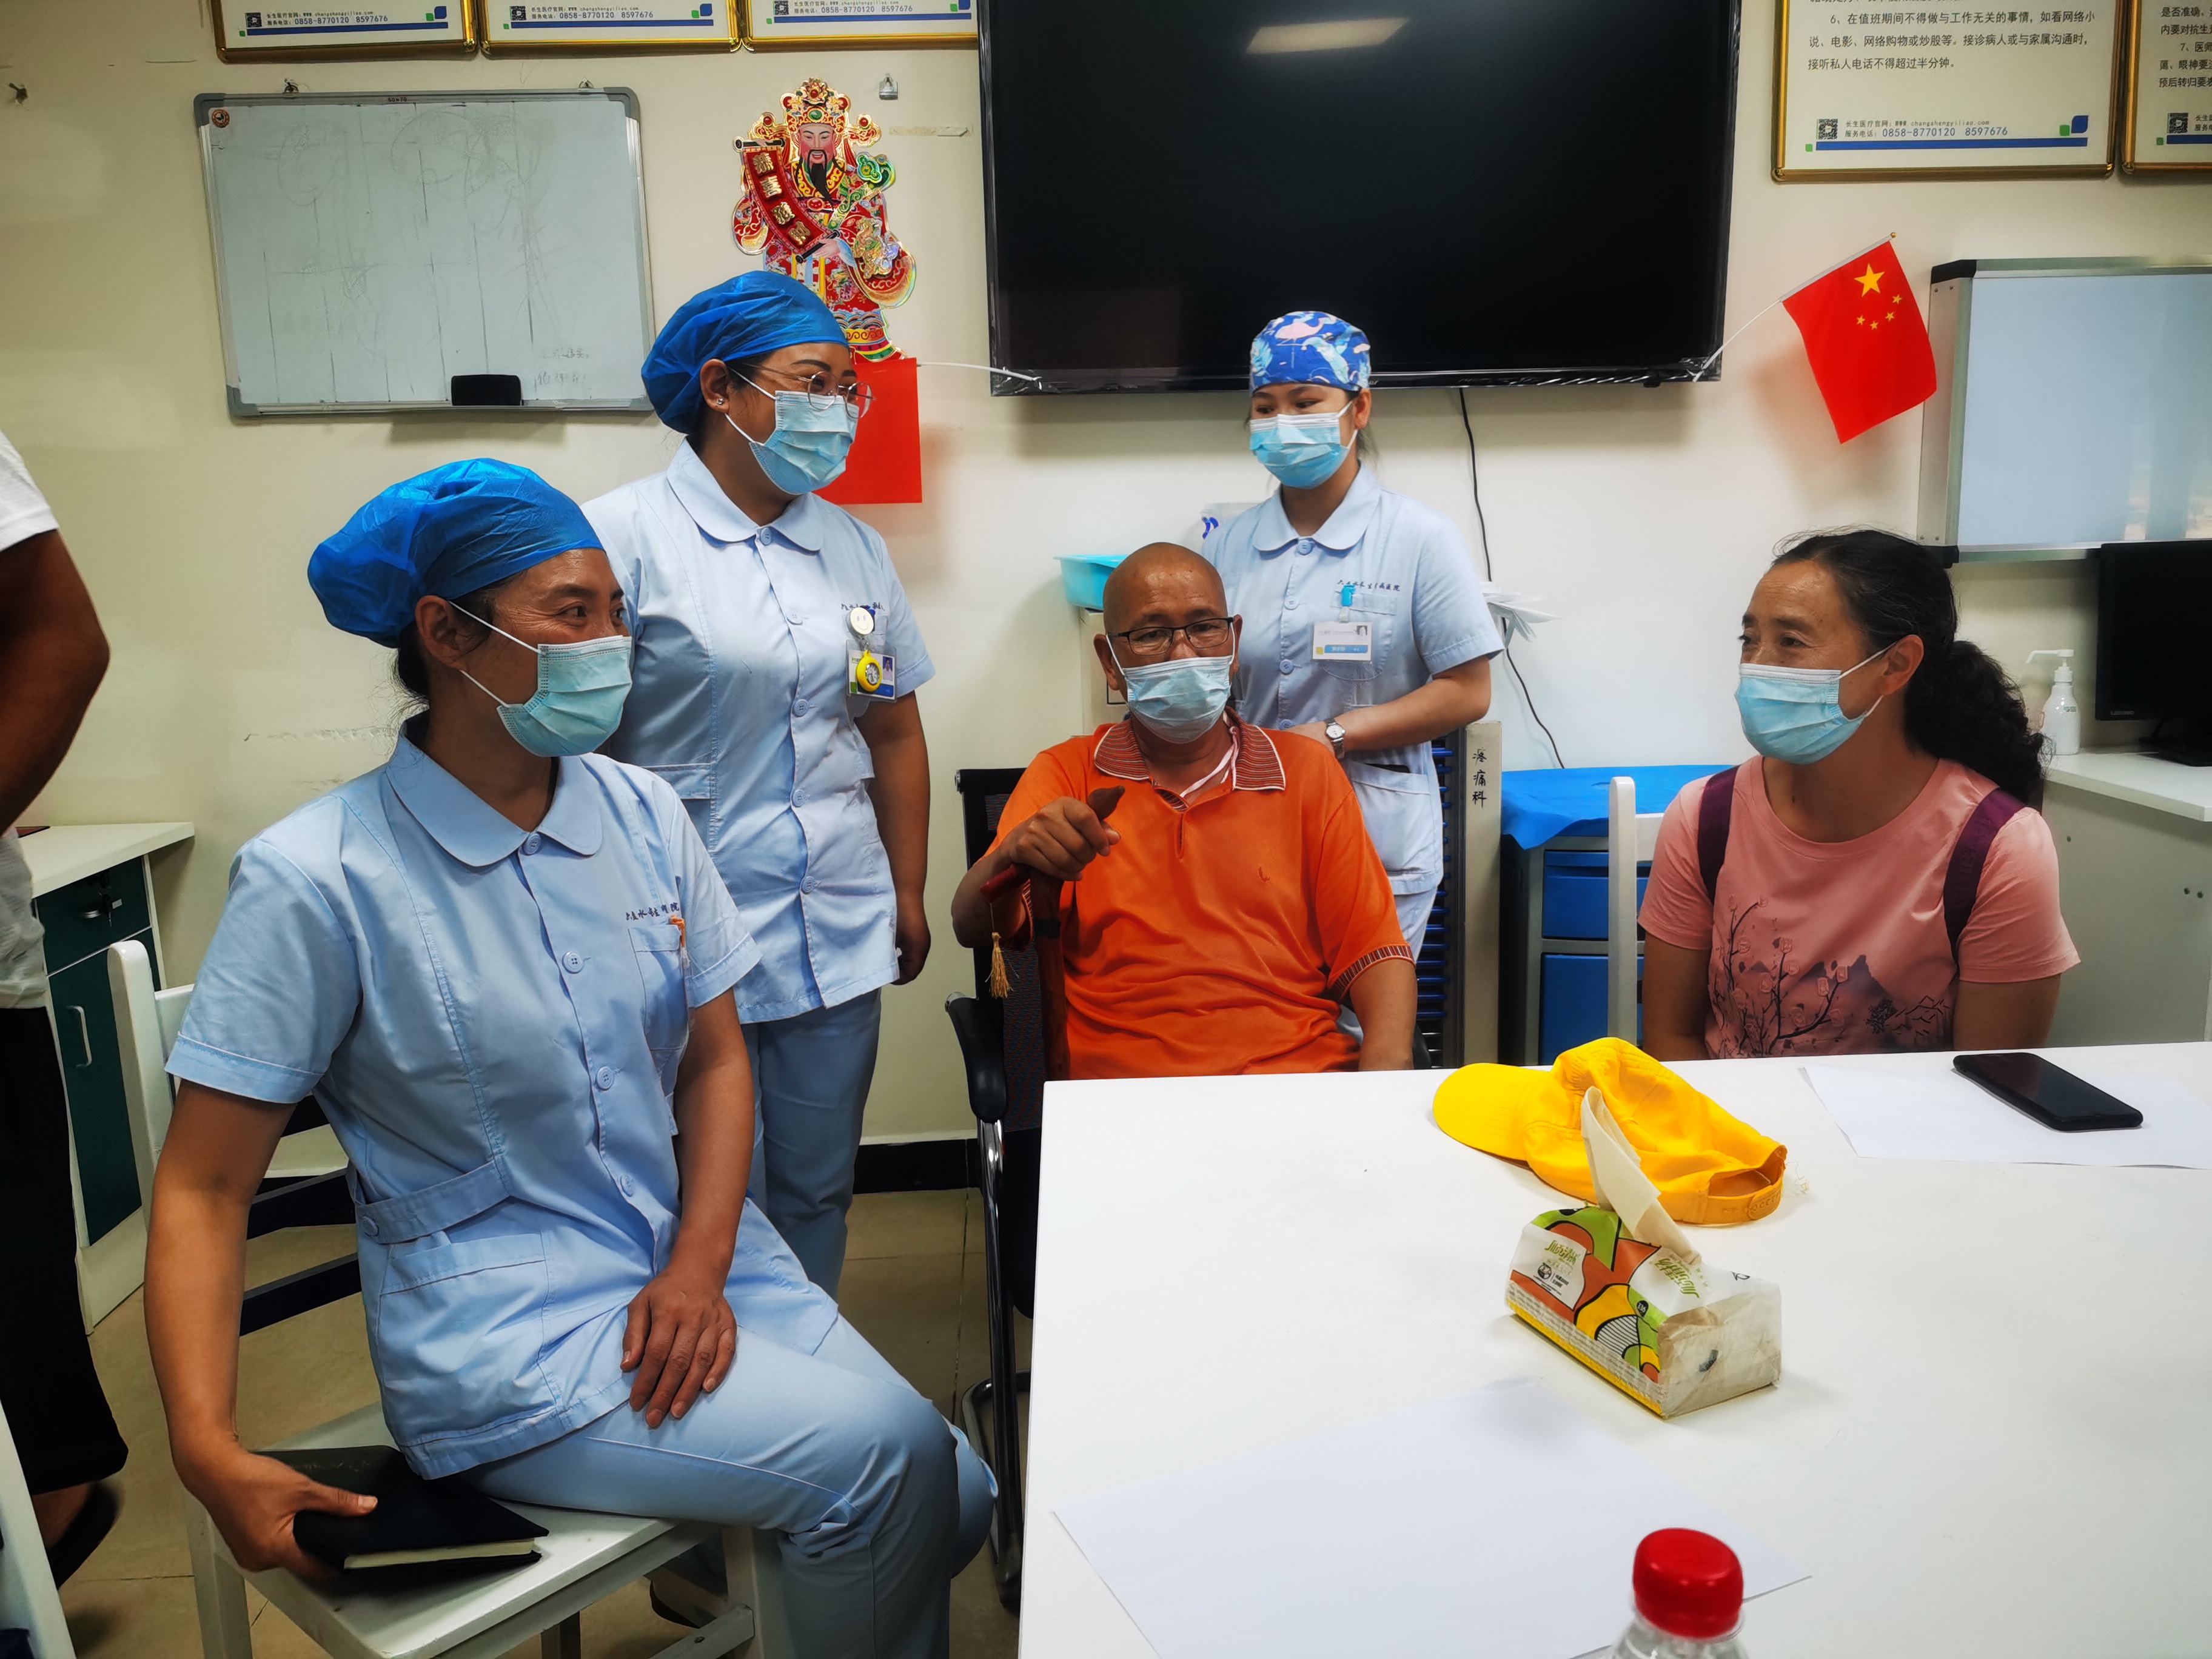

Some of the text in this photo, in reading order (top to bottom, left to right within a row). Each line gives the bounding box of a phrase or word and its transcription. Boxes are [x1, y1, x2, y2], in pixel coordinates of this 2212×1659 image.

[1808, 57, 1954, 70] 接听私人电话不得超过半分钟。
[1882, 127, 1956, 137] 0858-8770120
[1965, 127, 2008, 136] 8597676
[1472, 747, 1487, 809] 疼痛科
